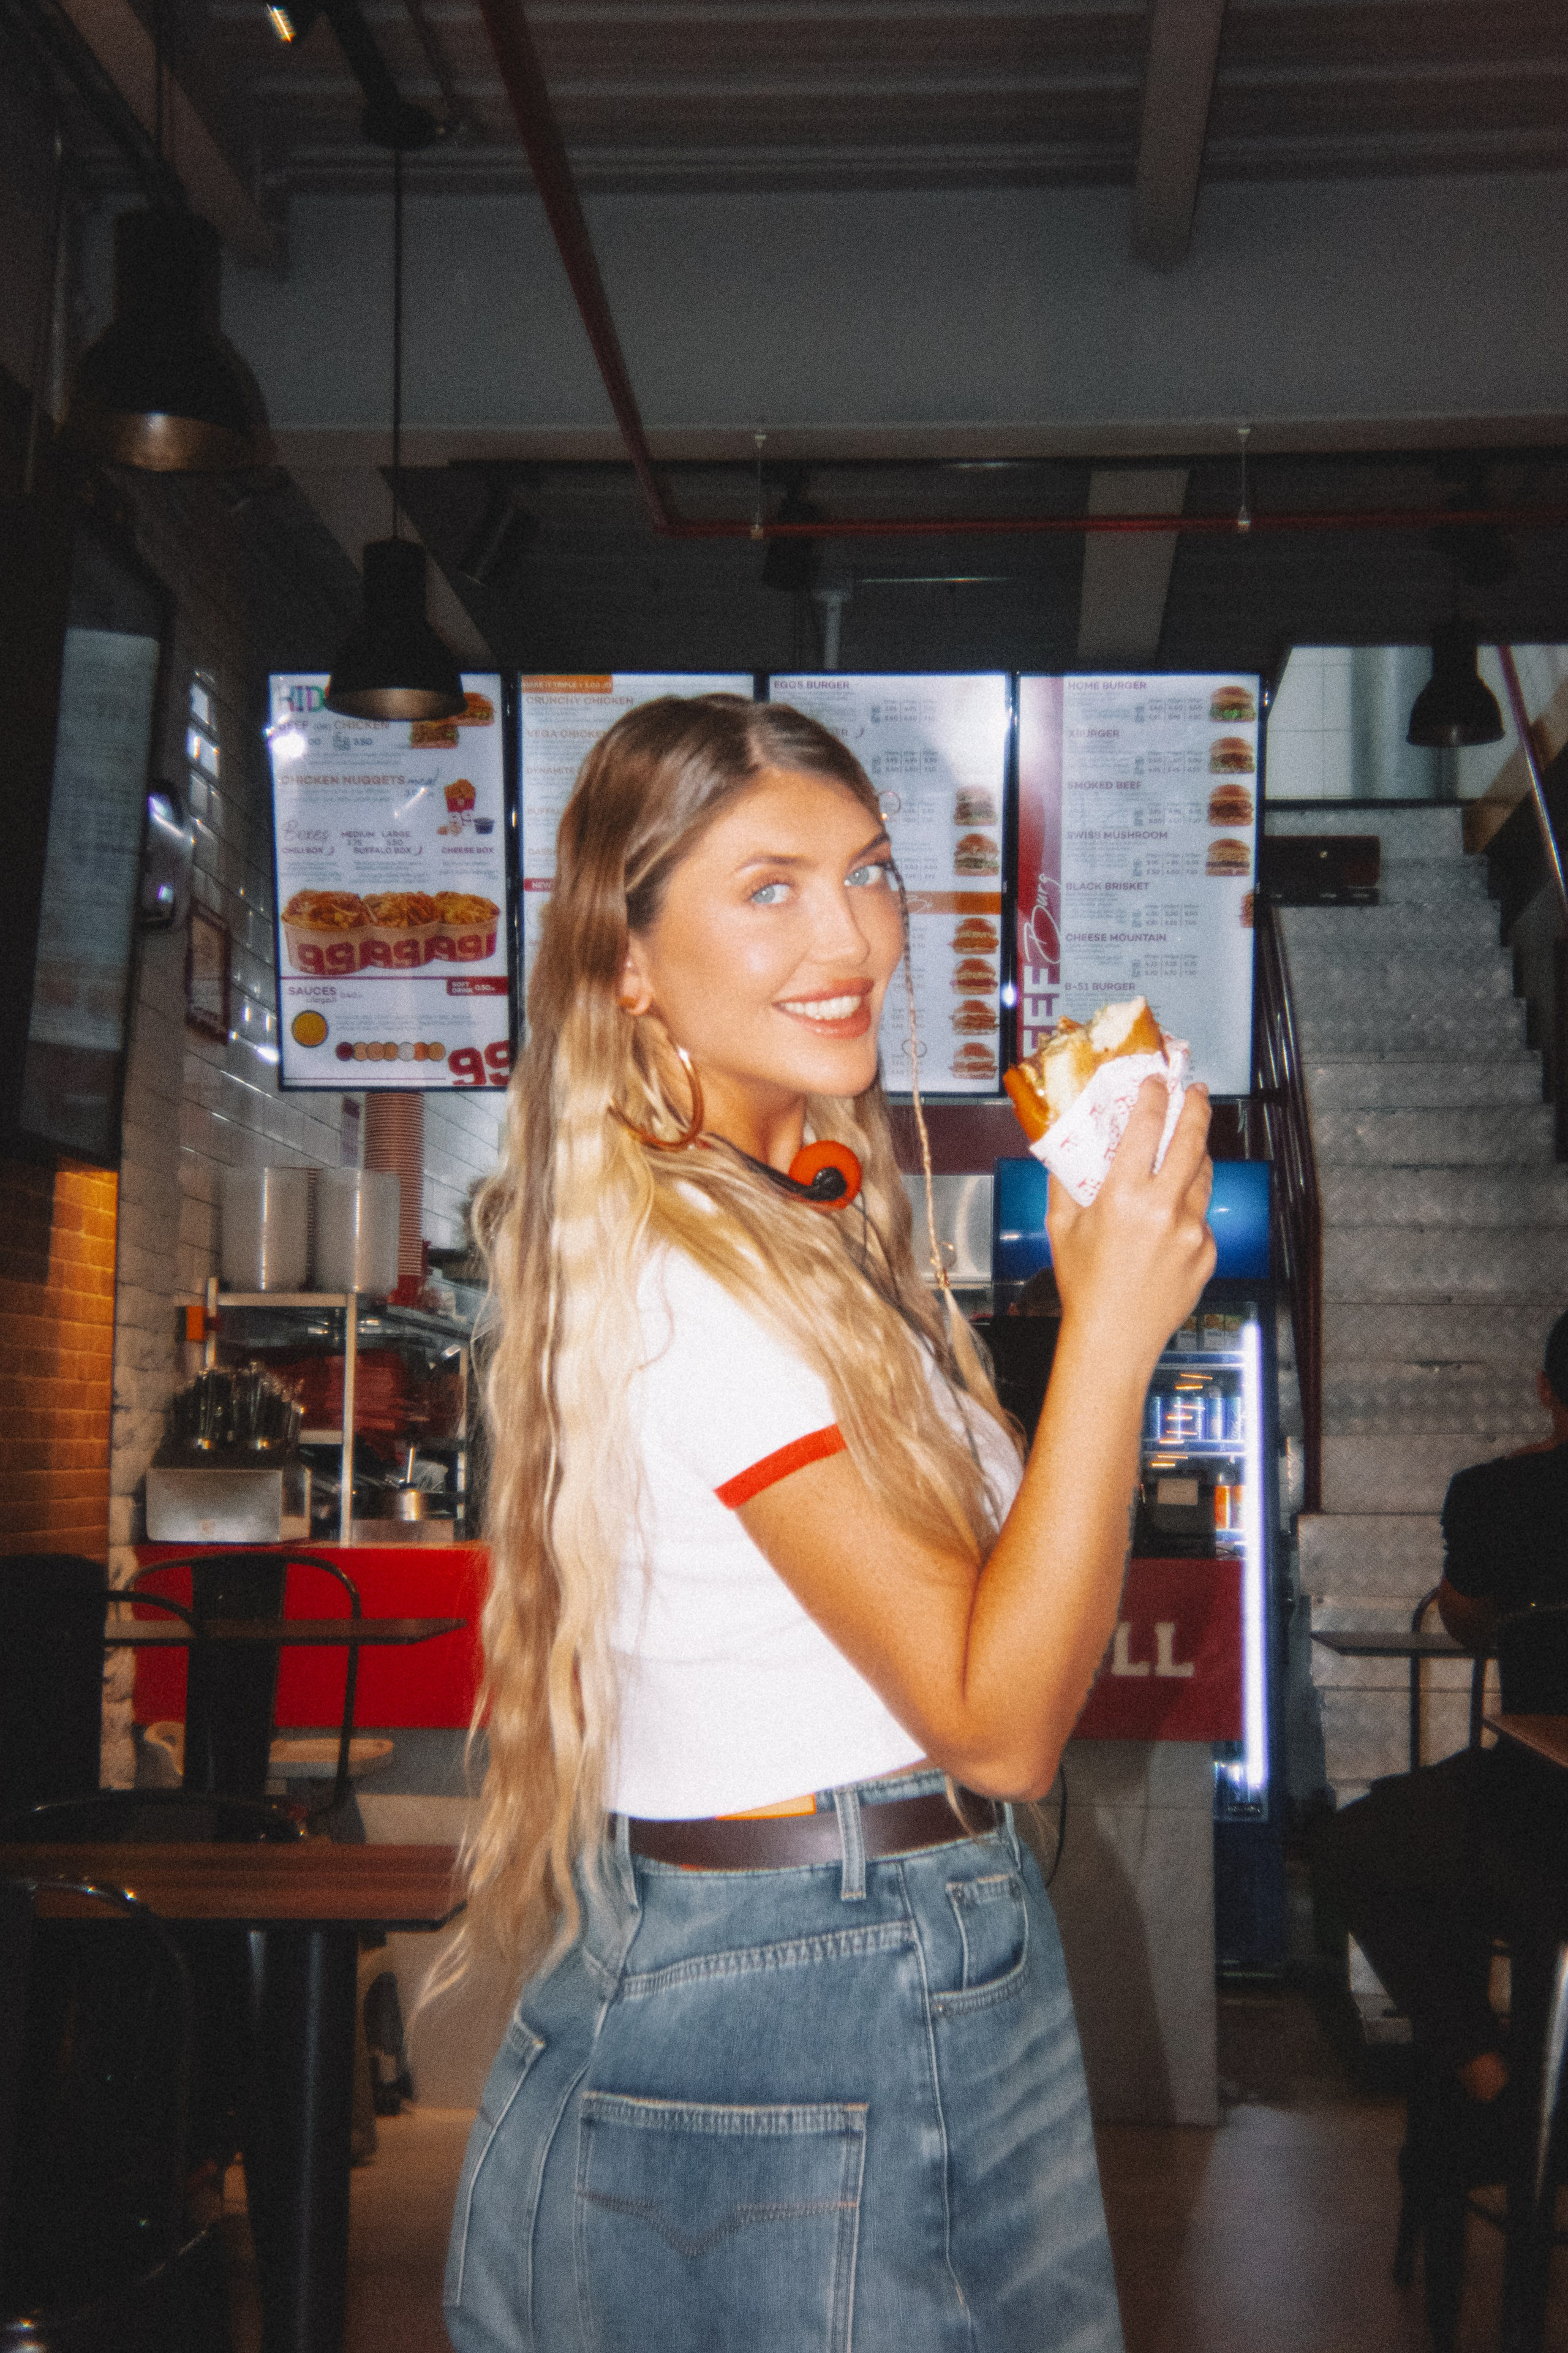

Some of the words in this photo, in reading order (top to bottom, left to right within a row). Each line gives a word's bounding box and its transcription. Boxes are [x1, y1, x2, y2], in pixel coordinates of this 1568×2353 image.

[806, 681, 850, 689] BURGER
[1068, 681, 1099, 690] HOME
[1102, 681, 1147, 690] BURGER
[526, 697, 580, 705] CRUNCHY
[583, 697, 633, 705] CHICKEN
[334, 720, 390, 730] CHICKEN
[560, 729, 608, 738] CHICKE
[342, 775, 406, 785] NUGGETS
[1066, 781, 1113, 790] SMOKED
[1115, 781, 1142, 790] BEEF
[1067, 831, 1101, 840] SWISS
[1103, 831, 1169, 840] MUSHROOM
[1065, 882, 1102, 891] BLACK
[1104, 882, 1150, 891] BRISKET
[1065, 933, 1107, 942] CHEESE
[1109, 933, 1167, 942] MOUNTAIN
[288, 986, 337, 995] SAUCES
[1091, 983, 1136, 991] BURGER
